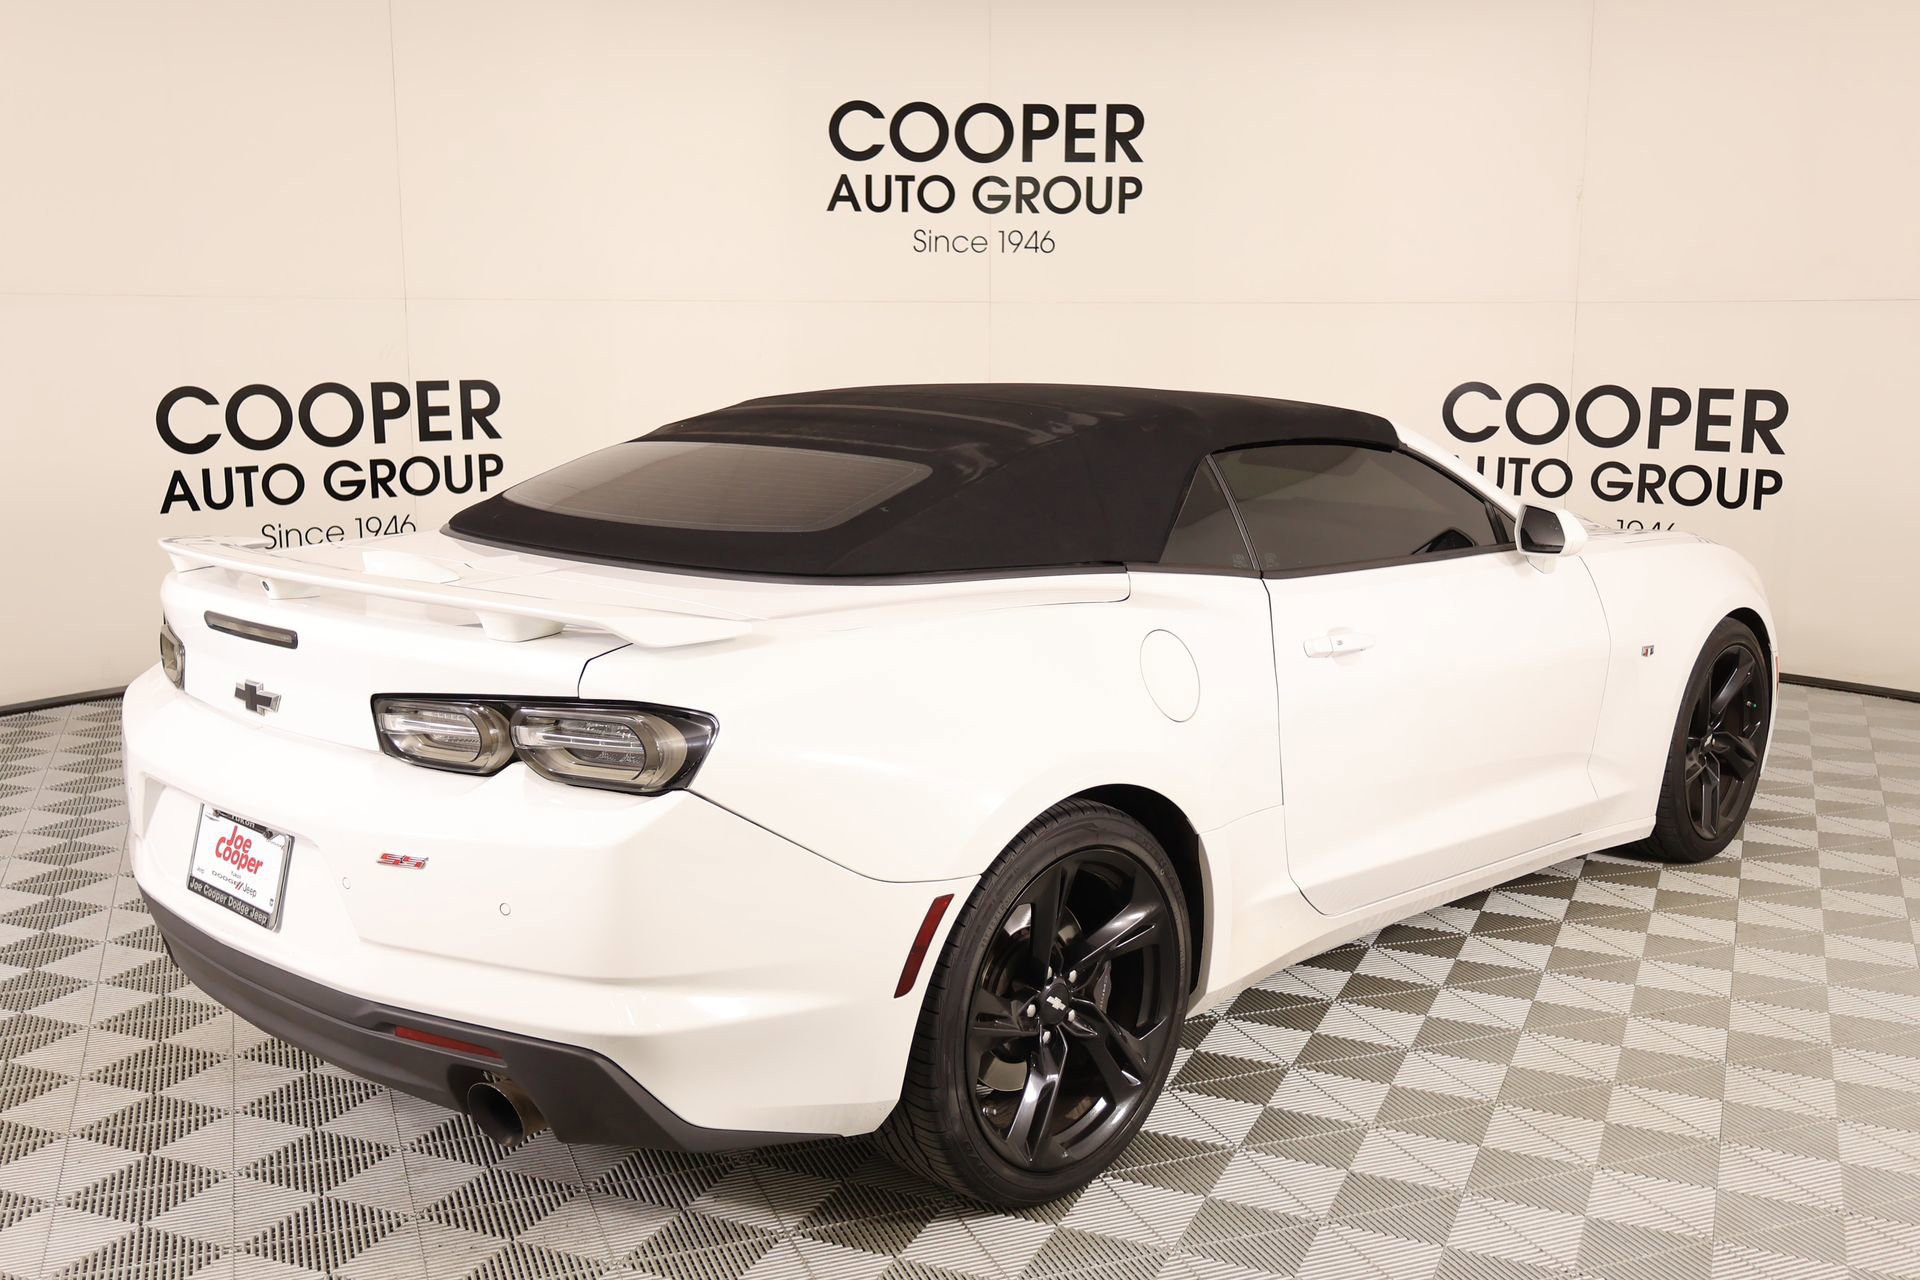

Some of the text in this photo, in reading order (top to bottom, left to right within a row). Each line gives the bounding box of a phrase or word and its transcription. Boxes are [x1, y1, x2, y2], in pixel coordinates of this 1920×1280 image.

[828, 99, 1145, 164] COOPER
[826, 173, 1143, 215] AUTO GROUP
[913, 228, 1056, 254] Since 1946
[155, 379, 503, 455] COOPER
[1441, 381, 1789, 456] COOPER
[160, 453, 504, 515] AUTO GROUP
[1455, 455, 1784, 511] UTO GROUP
[261, 513, 417, 550] Since 1946
[215, 836, 264, 874] Cooper
[226, 825, 252, 853] Joe
[190, 878, 203, 892] Joe
[203, 884, 228, 904] Cooper
[227, 895, 250, 916] Dodge
[250, 907, 268, 926] Jeep
[243, 883, 257, 898] Jeep
